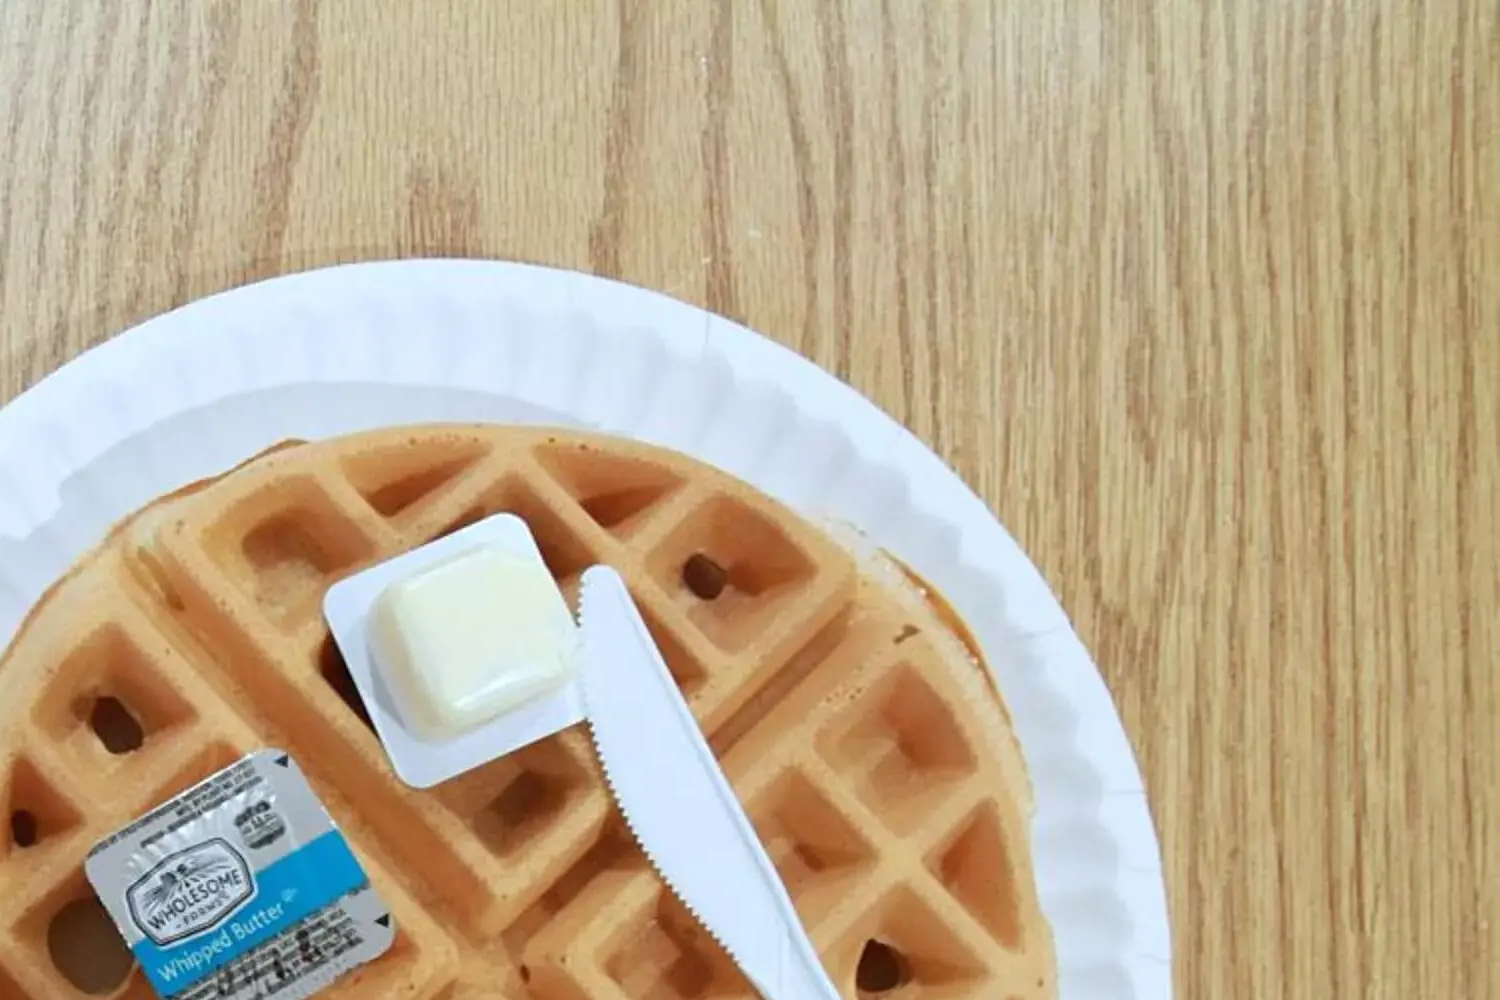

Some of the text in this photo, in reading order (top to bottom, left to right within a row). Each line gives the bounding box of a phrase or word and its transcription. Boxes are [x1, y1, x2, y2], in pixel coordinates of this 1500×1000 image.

[148, 868, 242, 931] WHOLESOME
[157, 902, 284, 982] Whipped Butter
